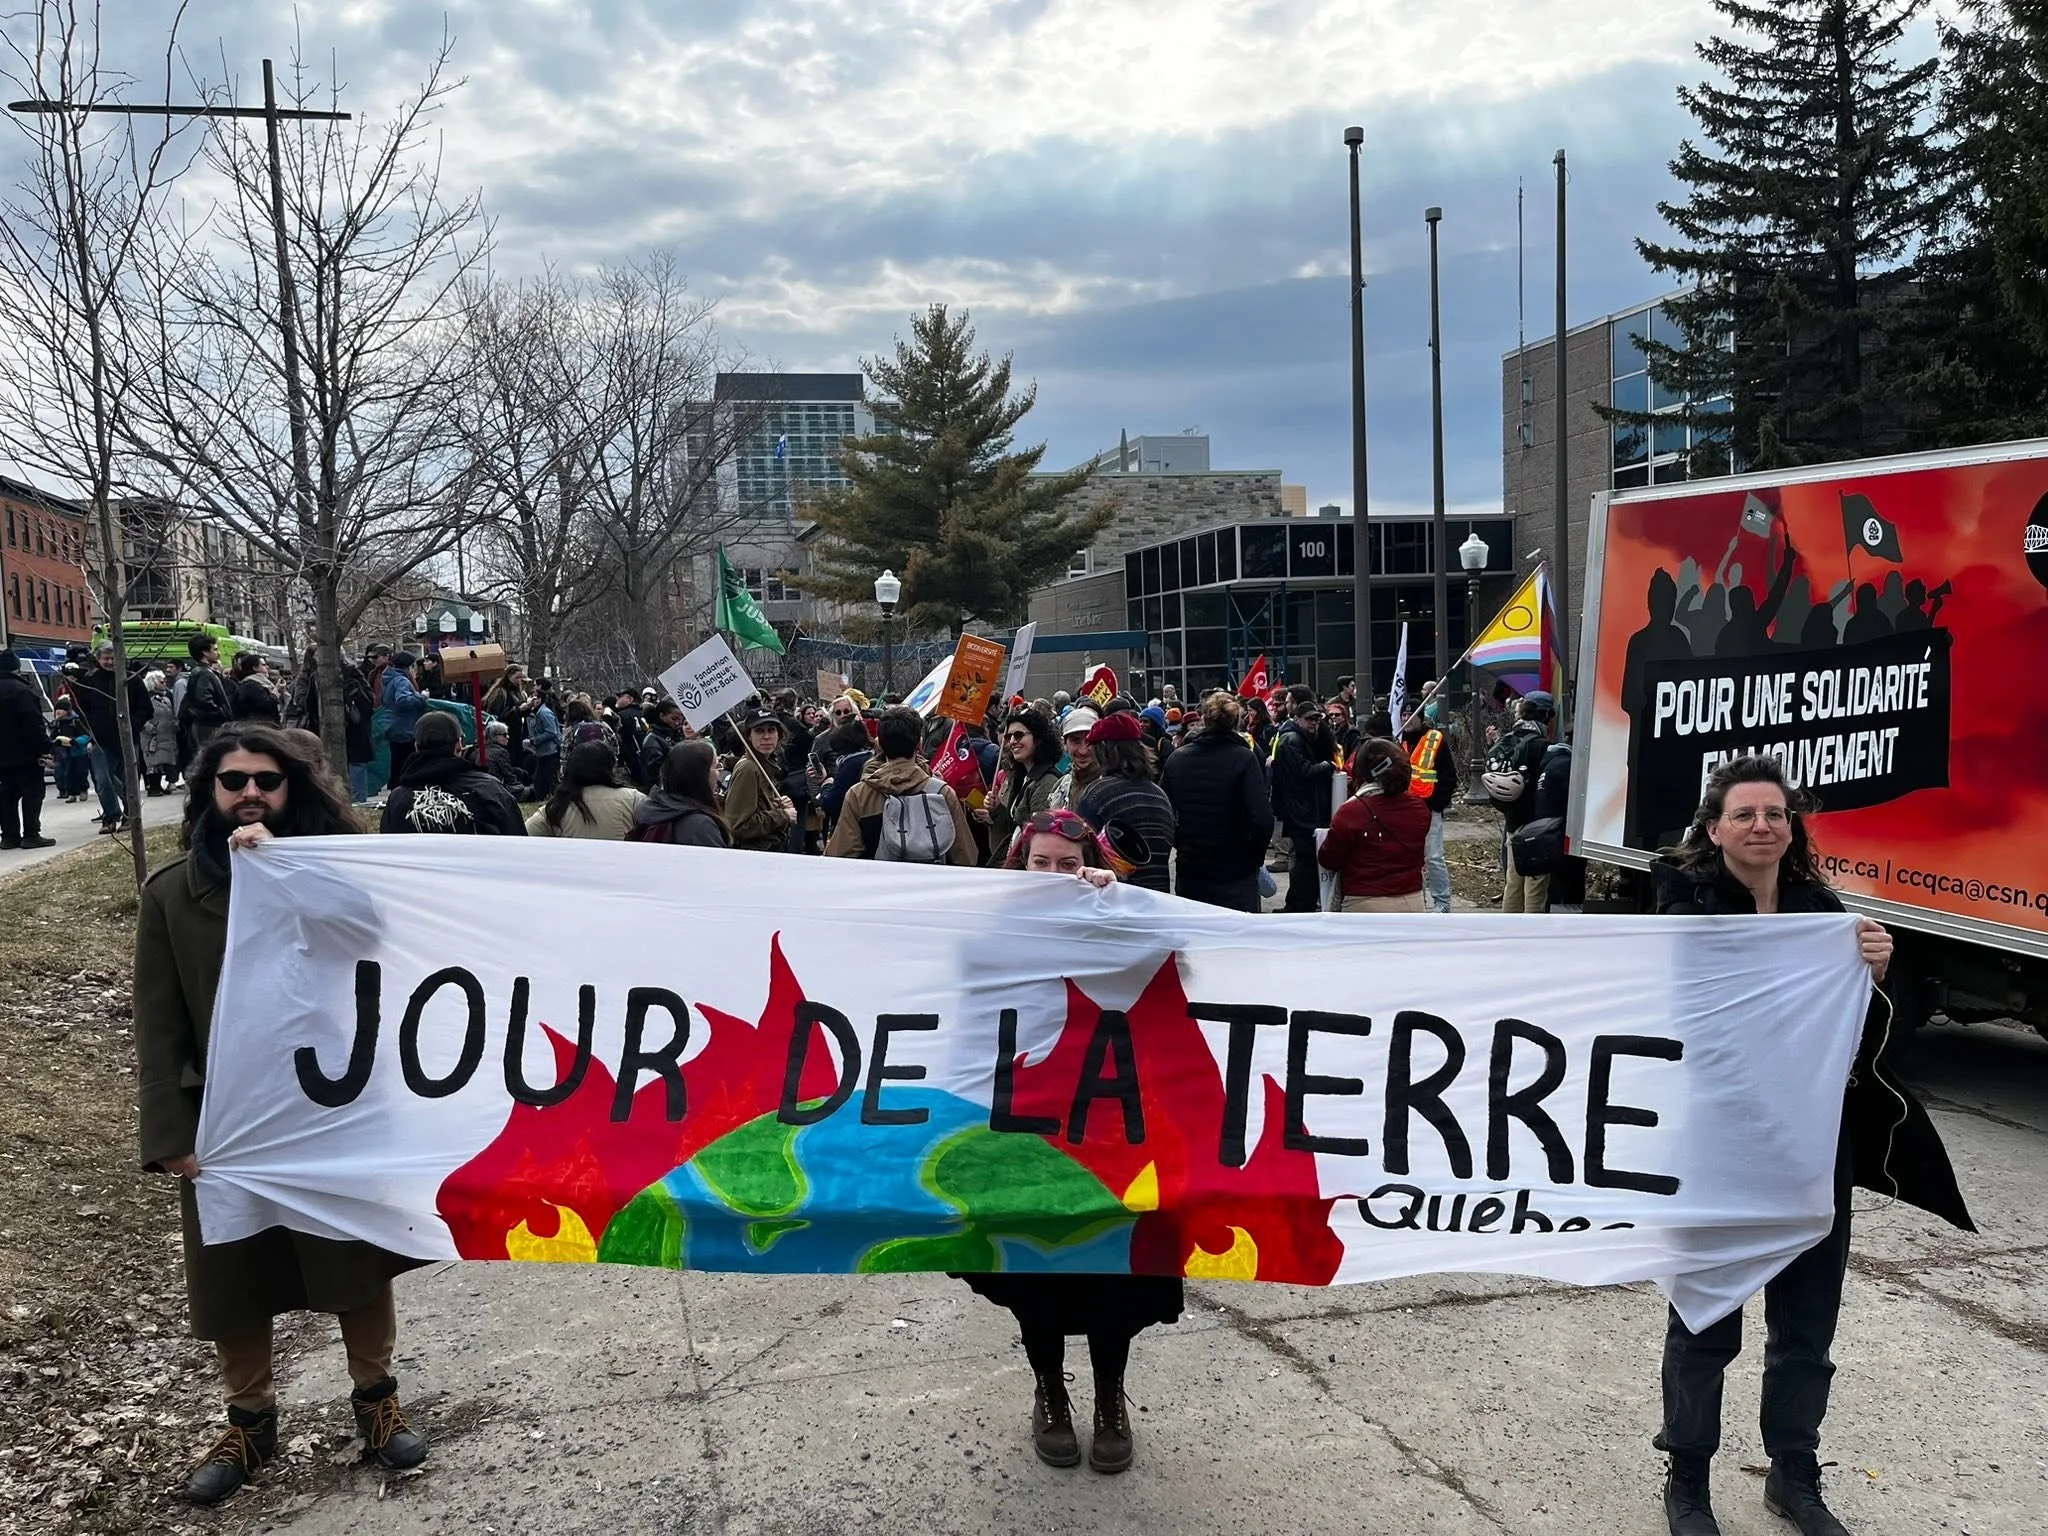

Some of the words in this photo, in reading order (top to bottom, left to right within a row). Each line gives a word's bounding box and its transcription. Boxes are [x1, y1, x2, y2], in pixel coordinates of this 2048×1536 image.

[1299, 541, 1325, 558] 100
[694, 655, 730, 682] Fondation
[699, 665, 733, 690] Monique-
[704, 672, 738, 698] Fitz-Back
[1653, 677, 1735, 738] POUR
[1741, 672, 1796, 728] UNE
[1801, 646, 1931, 721] SOLIDARITÉ
[1747, 727, 1899, 790] OUVEMENT
[295, 960, 690, 1123] JOUR
[777, 1001, 939, 1125] DE
[989, 1008, 1145, 1145] LA
[1187, 1001, 1683, 1195] TERRE
[1358, 1183, 1635, 1234] Québe
